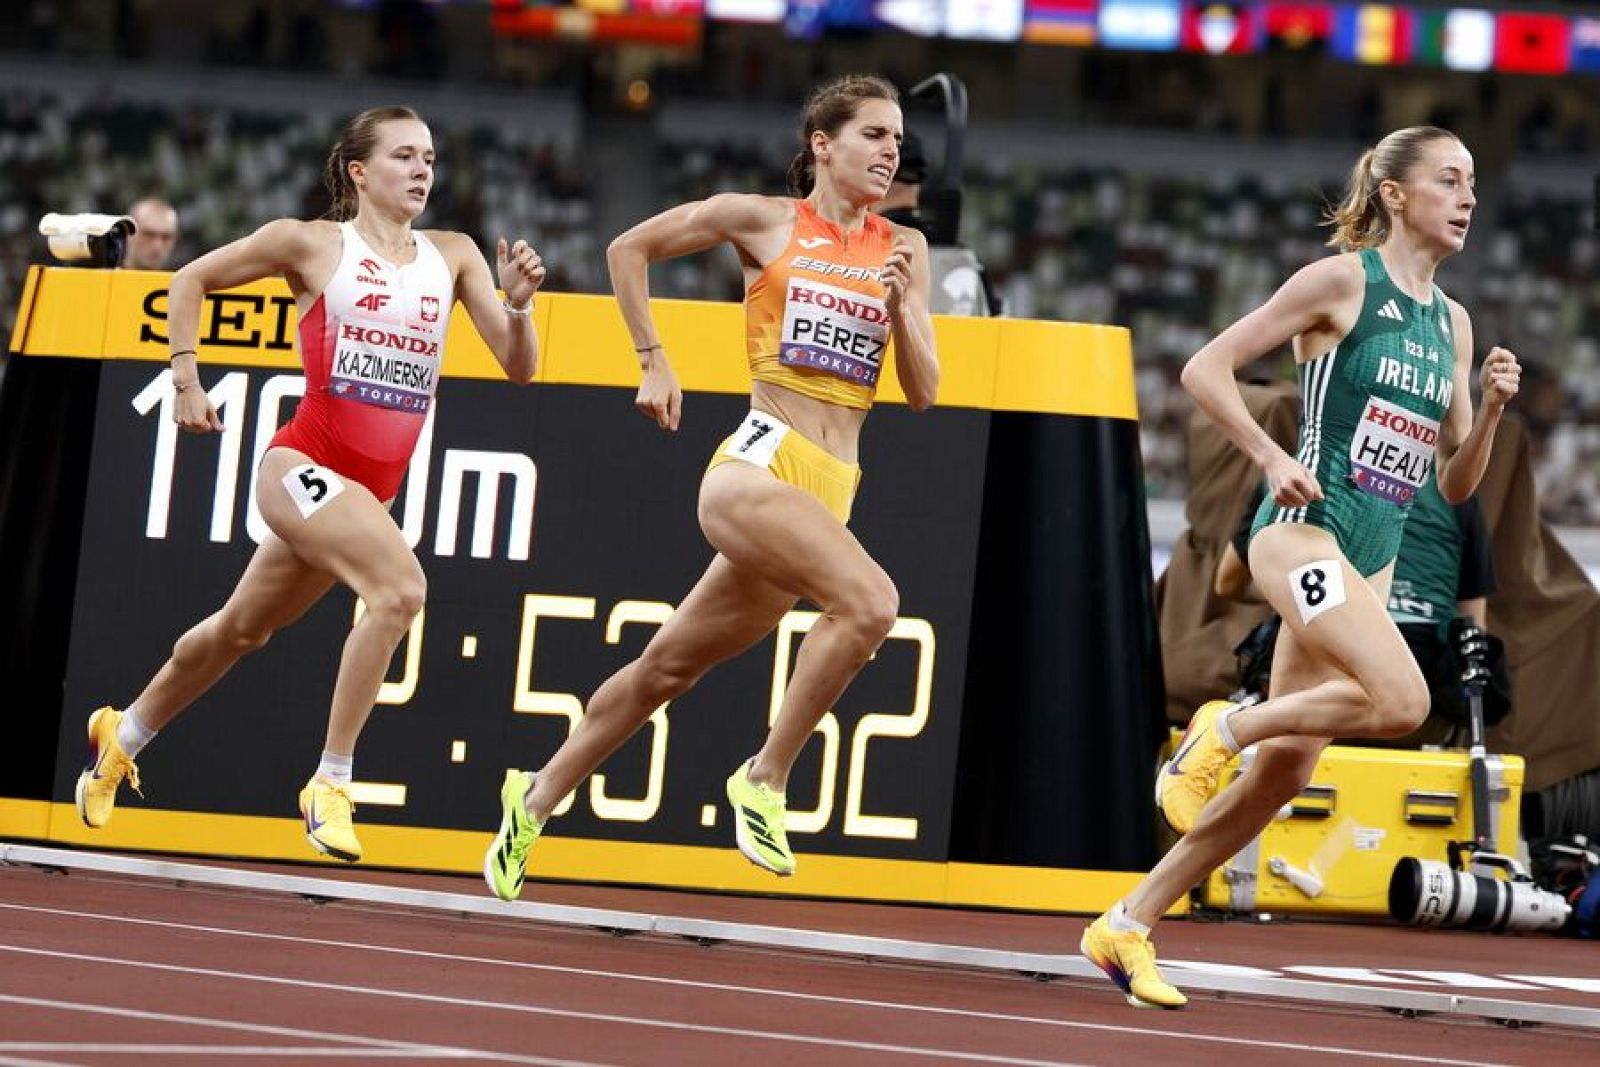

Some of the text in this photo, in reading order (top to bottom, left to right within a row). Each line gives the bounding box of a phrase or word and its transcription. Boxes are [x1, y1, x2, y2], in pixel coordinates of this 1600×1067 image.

[356, 274, 388, 287] ORLEN
[355, 293, 392, 312] 4F
[792, 317, 885, 363] PÉREZ
[1365, 404, 1438, 447] HOND
[1358, 435, 1432, 484] HEALY
[298, 467, 328, 503] 5
[1301, 568, 1327, 607] 8
